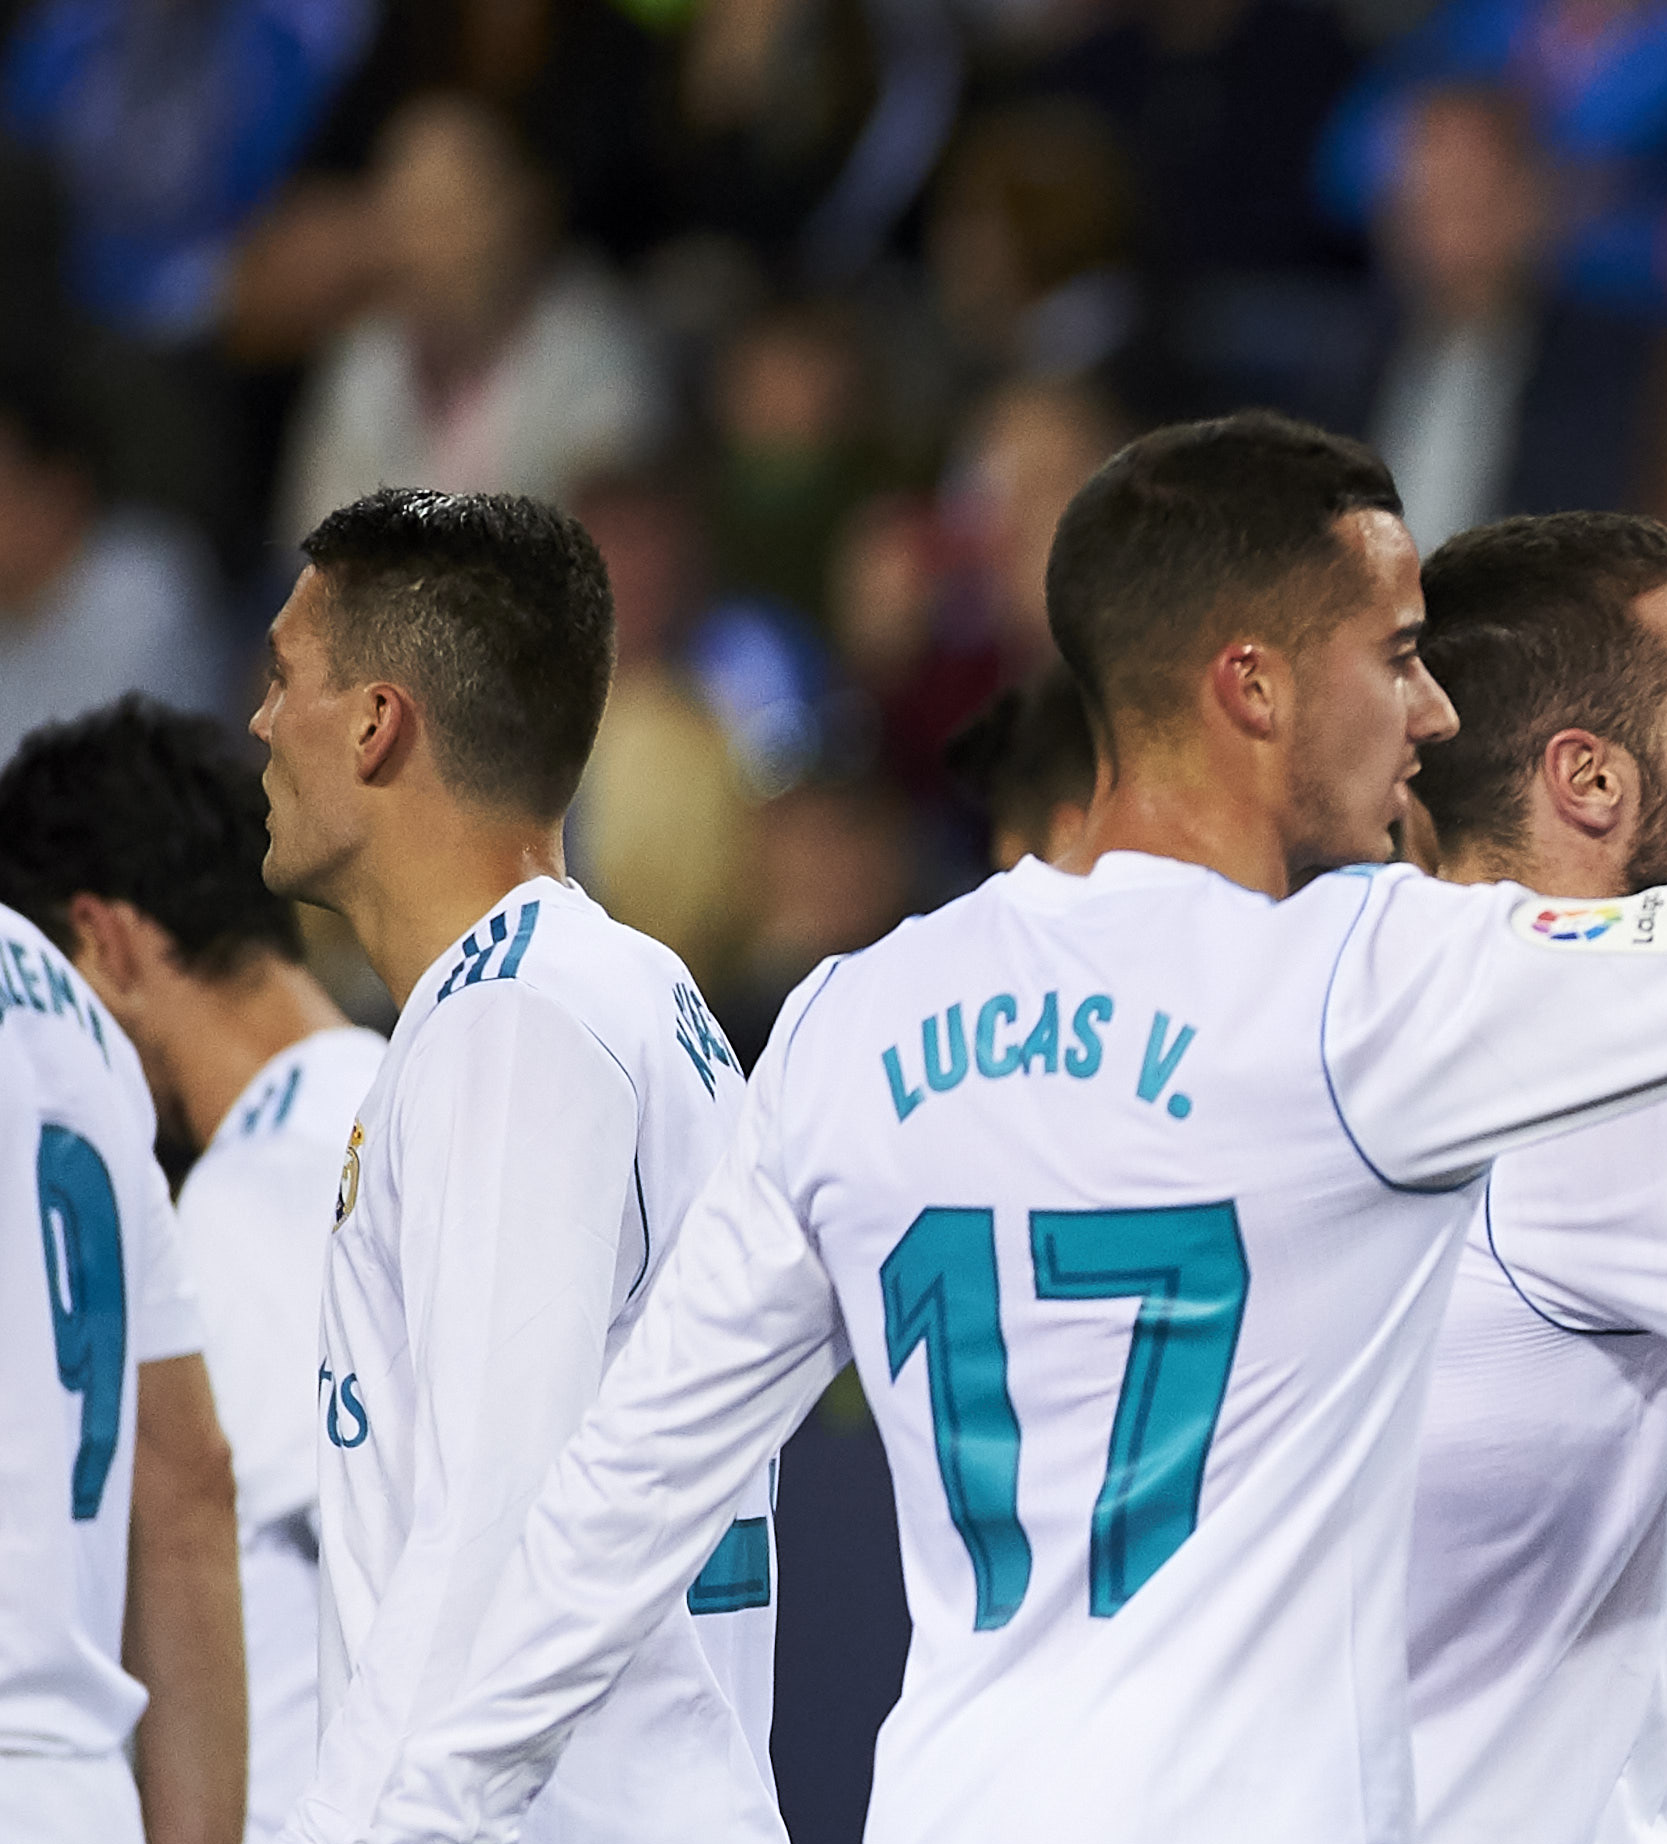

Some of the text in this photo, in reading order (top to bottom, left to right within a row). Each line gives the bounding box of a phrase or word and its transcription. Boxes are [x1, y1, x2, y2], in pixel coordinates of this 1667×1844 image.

[881, 991, 1113, 1123] LUCAS
[1136, 1010, 1197, 1121] V.
[36, 1122, 127, 1520] 9
[879, 1199, 1250, 1632] 17
